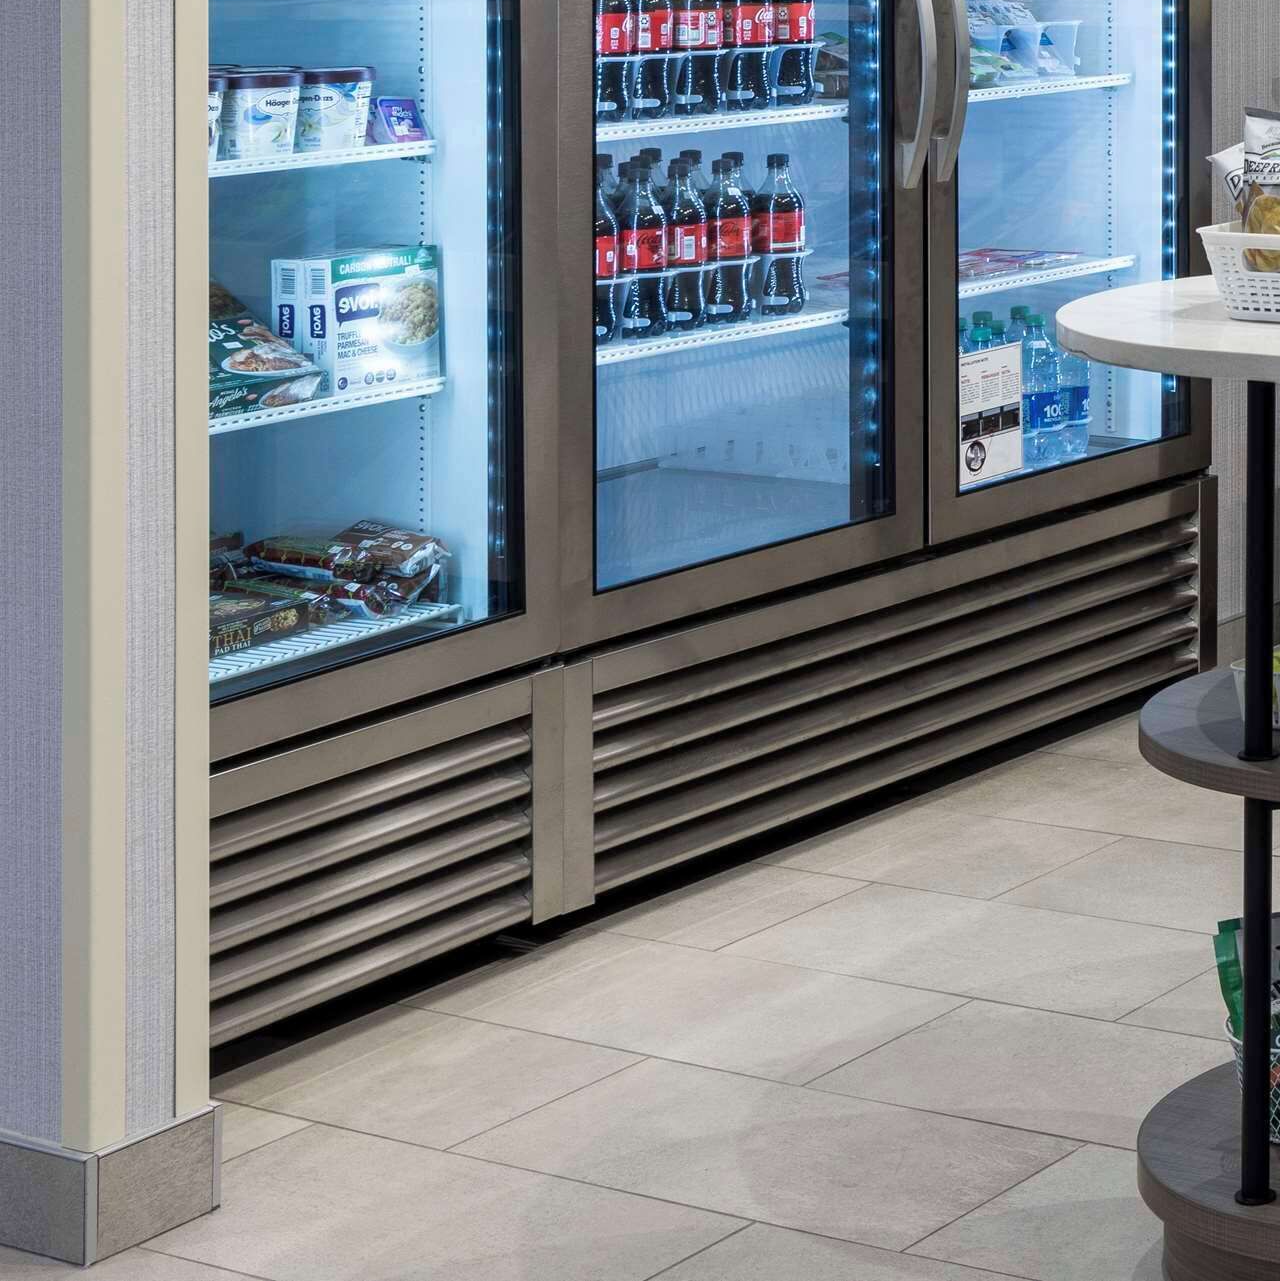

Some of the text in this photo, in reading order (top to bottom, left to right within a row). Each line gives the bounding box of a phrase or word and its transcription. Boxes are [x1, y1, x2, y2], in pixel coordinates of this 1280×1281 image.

[281, 306, 293, 337] evol.
[312, 306, 324, 338] evol.
[337, 350, 350, 359] MAC
[357, 345, 378, 357] CHEESE
[214, 627, 252, 649] THAI
[214, 640, 251, 656] PAD THAI
